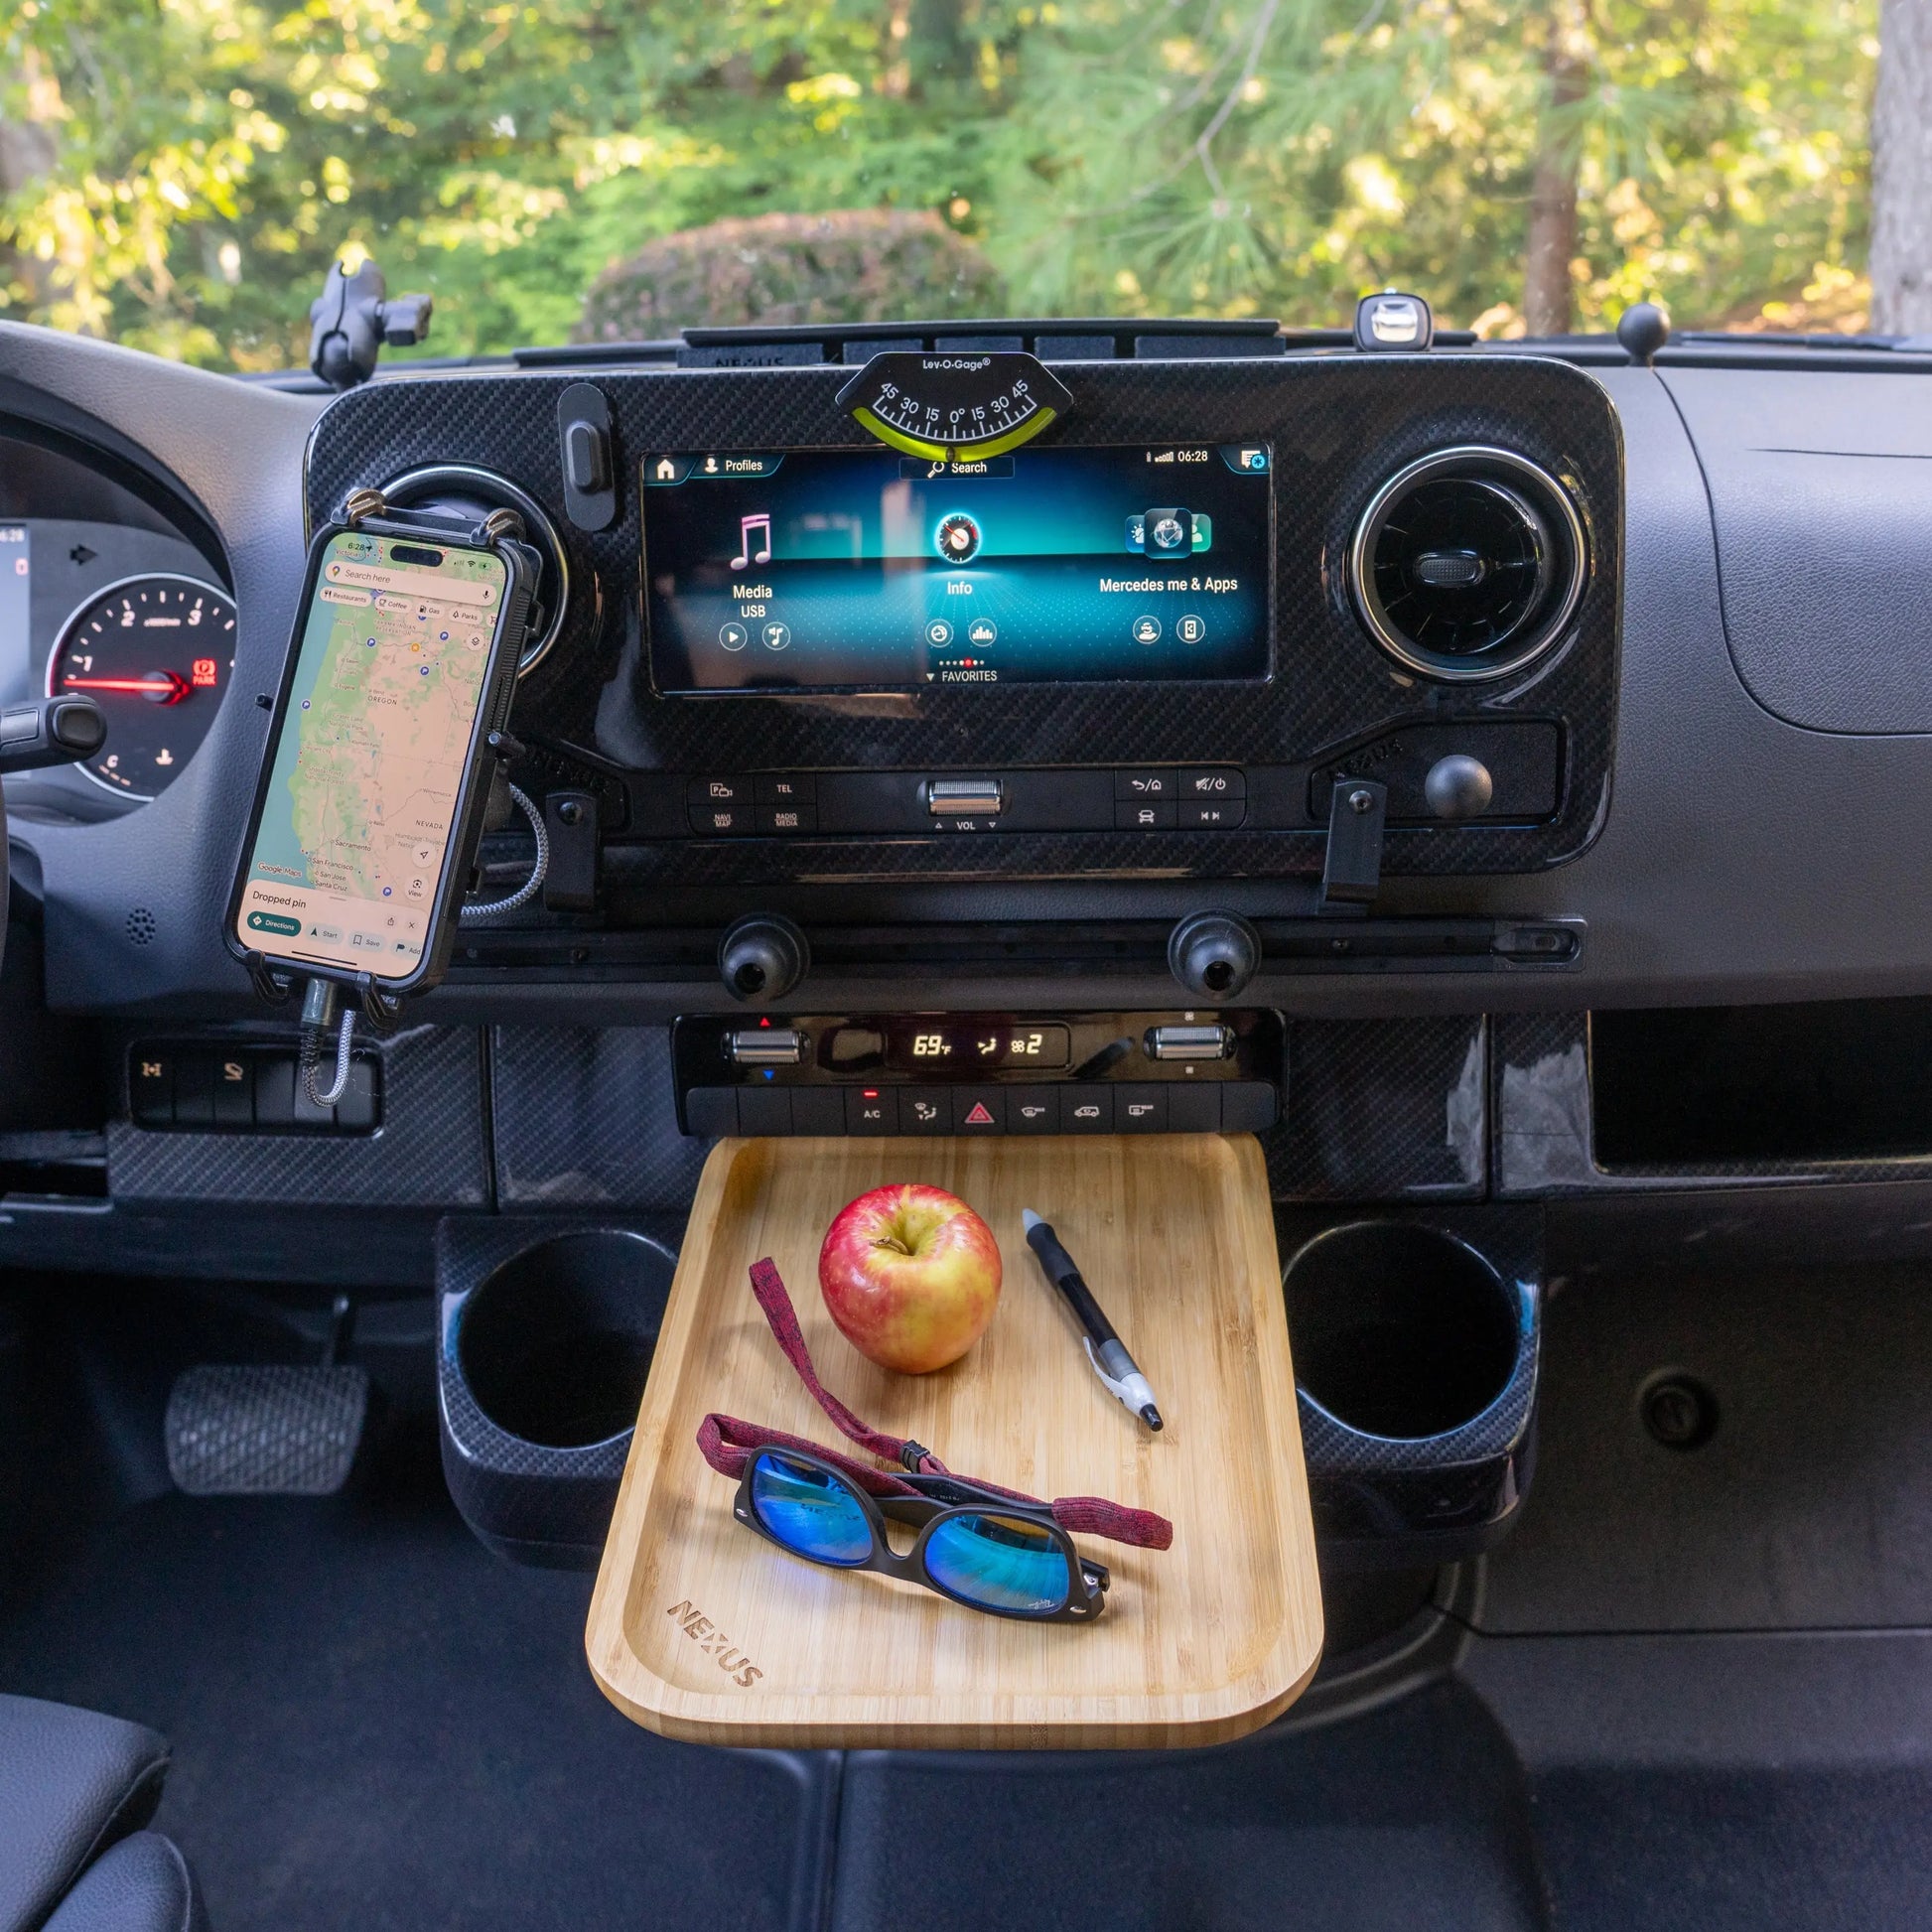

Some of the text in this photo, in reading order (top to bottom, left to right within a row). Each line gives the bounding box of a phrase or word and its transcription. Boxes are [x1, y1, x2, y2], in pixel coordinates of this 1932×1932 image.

[881, 382, 899, 399] 45
[900, 397, 919, 414] 30
[925, 407, 940, 422] 15
[971, 406, 986, 421] 15
[991, 396, 1010, 413] 30
[1012, 379, 1029, 398] 45
[1176, 450, 1209, 464] 06:28
[725, 459, 763, 473] Profiles
[951, 461, 988, 475] Search
[347, 542, 365, 551] 6:28
[345, 569, 391, 584] Search here
[732, 585, 773, 600] Media
[946, 581, 973, 596] Info
[1099, 577, 1238, 594] Mercedes me & Apps
[333, 593, 367, 604] Restaurants
[387, 601, 408, 610] Coffee
[120, 611, 135, 627] 2
[188, 610, 202, 625] 3
[461, 613, 479, 621] Parks
[741, 605, 766, 619] USB
[941, 669, 998, 683] FAVORITES
[367, 696, 398, 706] OREGON
[776, 784, 792, 793] TEL
[415, 819, 444, 830] NEVADA
[956, 820, 976, 830] VOL
[335, 839, 371, 852] Sacramento
[258, 862, 302, 878] Google Maps
[312, 857, 353, 871] San Francisco
[331, 873, 346, 882] Jose
[315, 880, 348, 892] Santa Cruz
[252, 891, 307, 909] Dropped pin
[407, 889, 422, 898] View
[264, 918, 295, 931] Directions
[322, 929, 338, 939] Start
[365, 938, 380, 948] Save
[1026, 1034, 1042, 1054] 2
[863, 1109, 881, 1119] A/C
[667, 1599, 763, 1688] NEXUS
